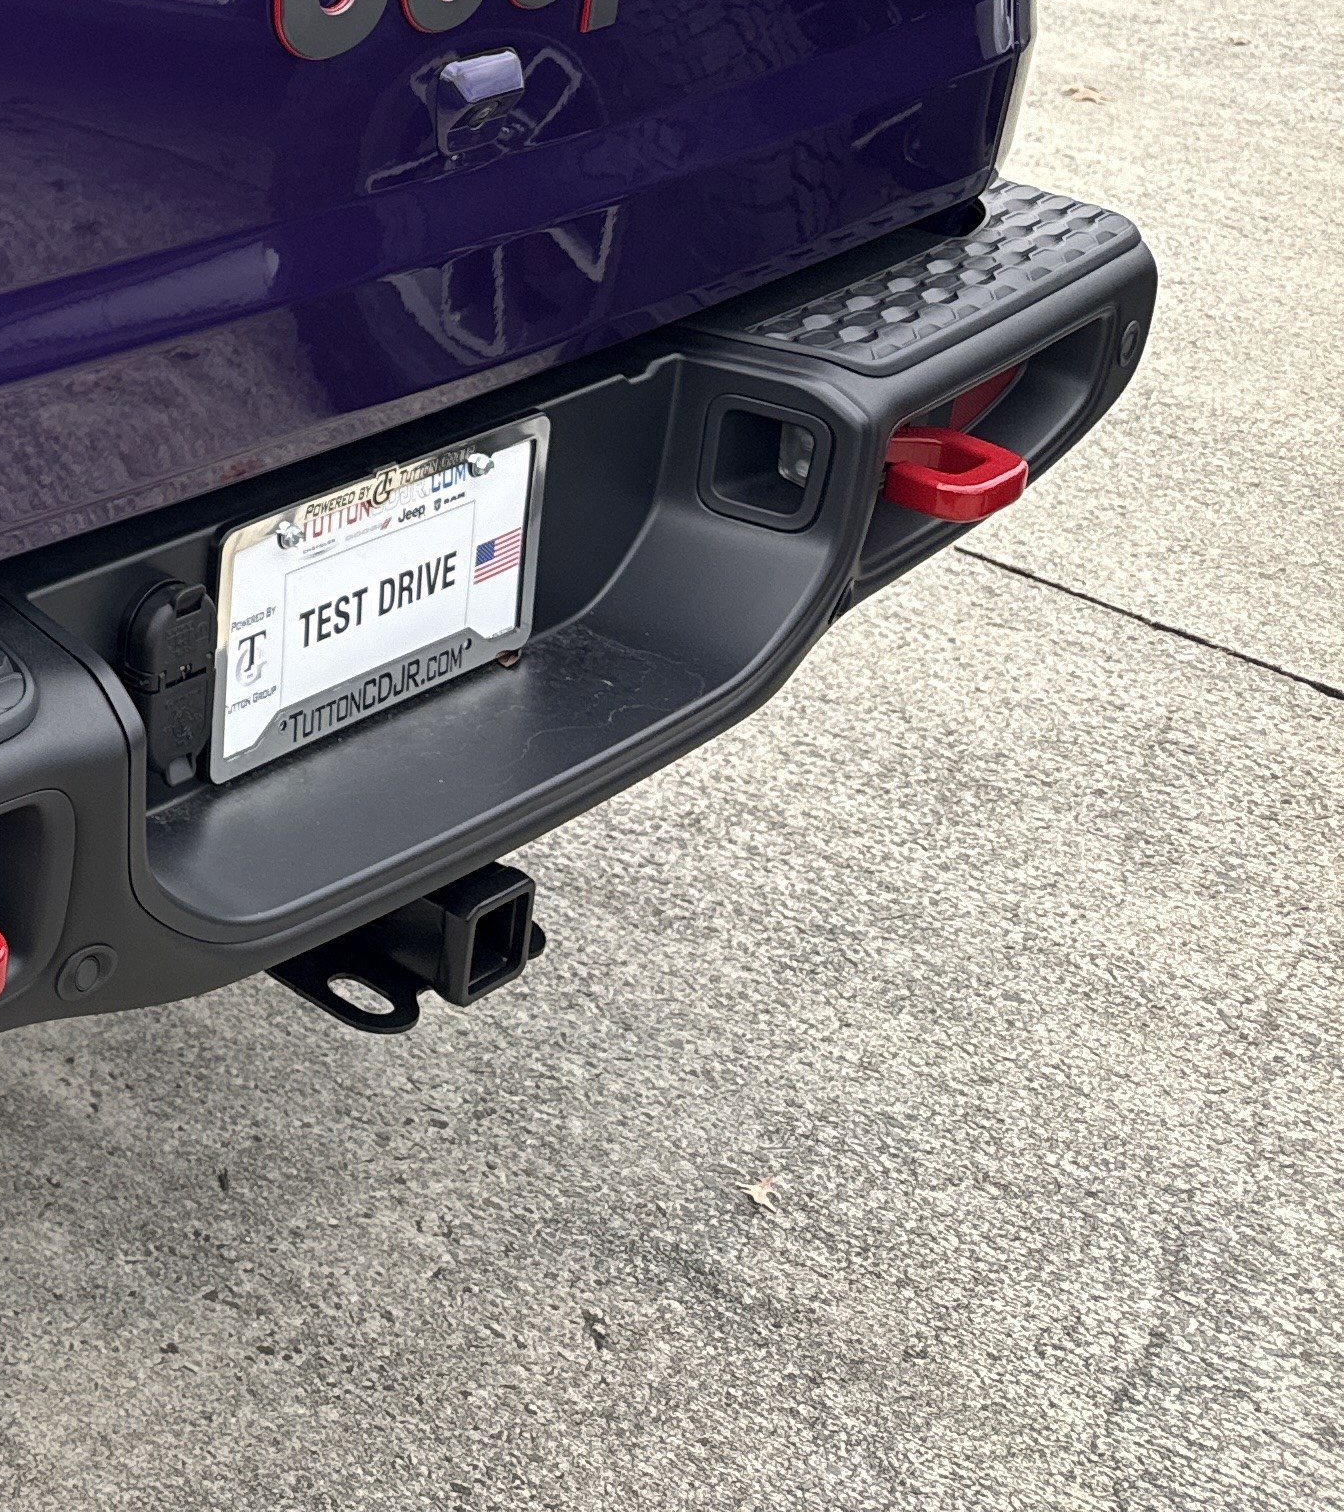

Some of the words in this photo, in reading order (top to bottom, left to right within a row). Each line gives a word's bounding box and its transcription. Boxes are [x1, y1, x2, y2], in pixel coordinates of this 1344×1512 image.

[304, 490, 356, 520] POWERED
[358, 484, 372, 501] BY
[398, 504, 426, 523] Jeep
[299, 586, 369, 648] TEST
[377, 550, 457, 617] DRIVE
